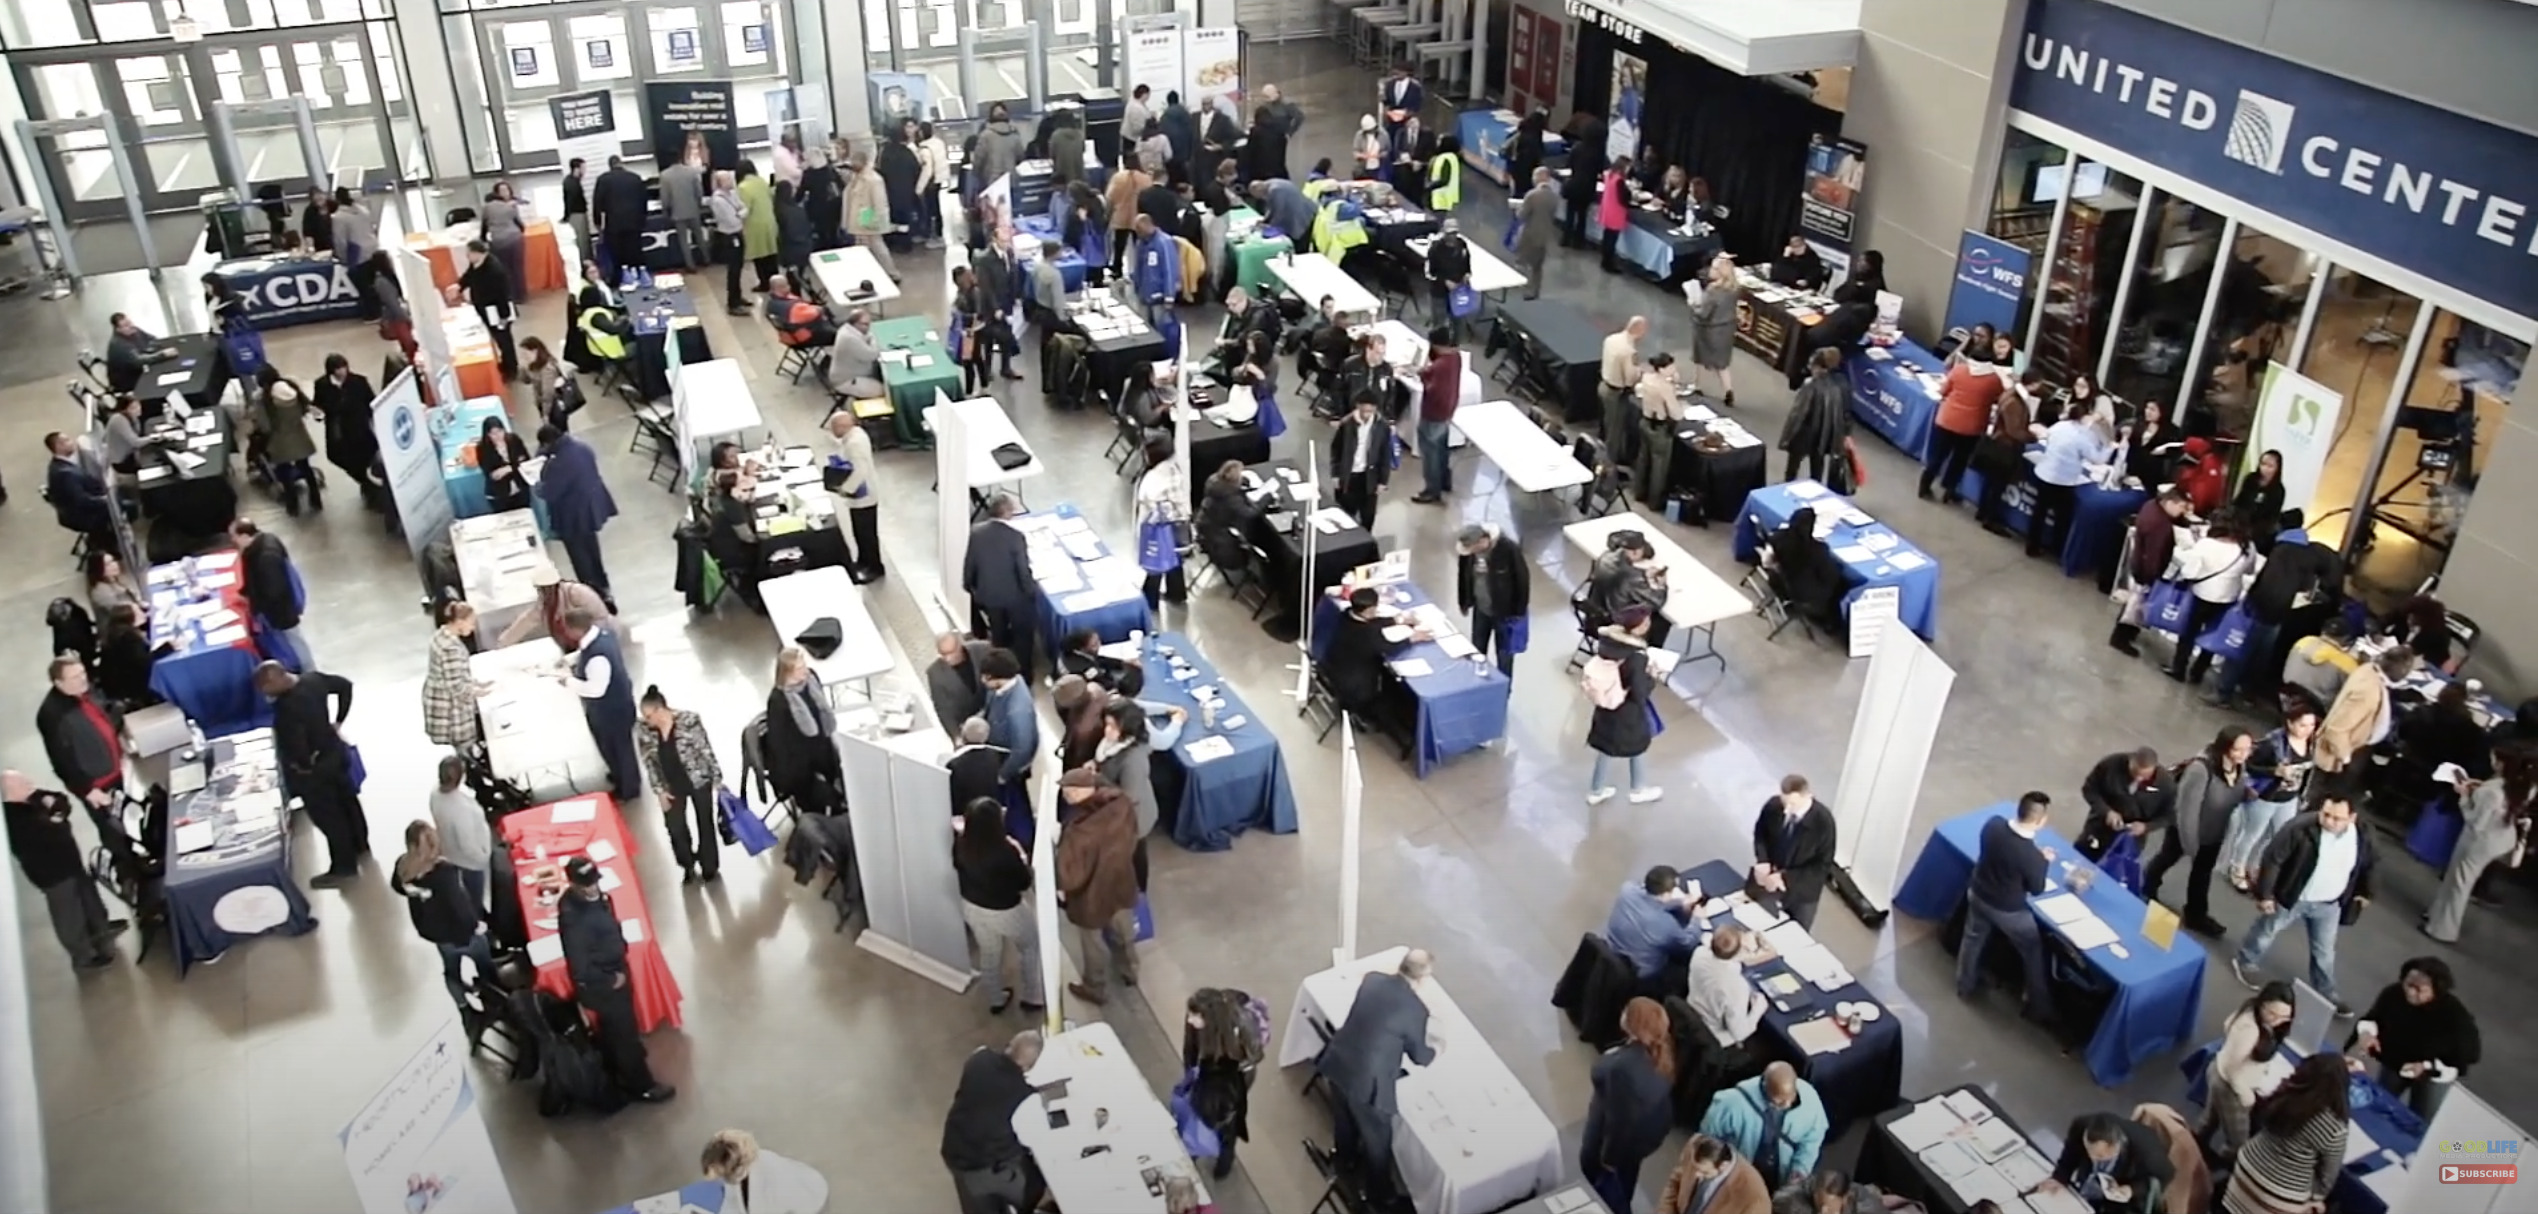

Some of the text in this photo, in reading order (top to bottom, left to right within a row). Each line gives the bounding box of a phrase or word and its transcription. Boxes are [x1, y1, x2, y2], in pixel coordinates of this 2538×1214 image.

[1565, 0, 1642, 44] TEAM STORE
[564, 113, 604, 131] HERE
[2024, 33, 2538, 256] UNITED CENTE
[265, 264, 360, 307] CDA
[1992, 265, 2024, 288] WFS
[1879, 389, 1903, 415] WFS
